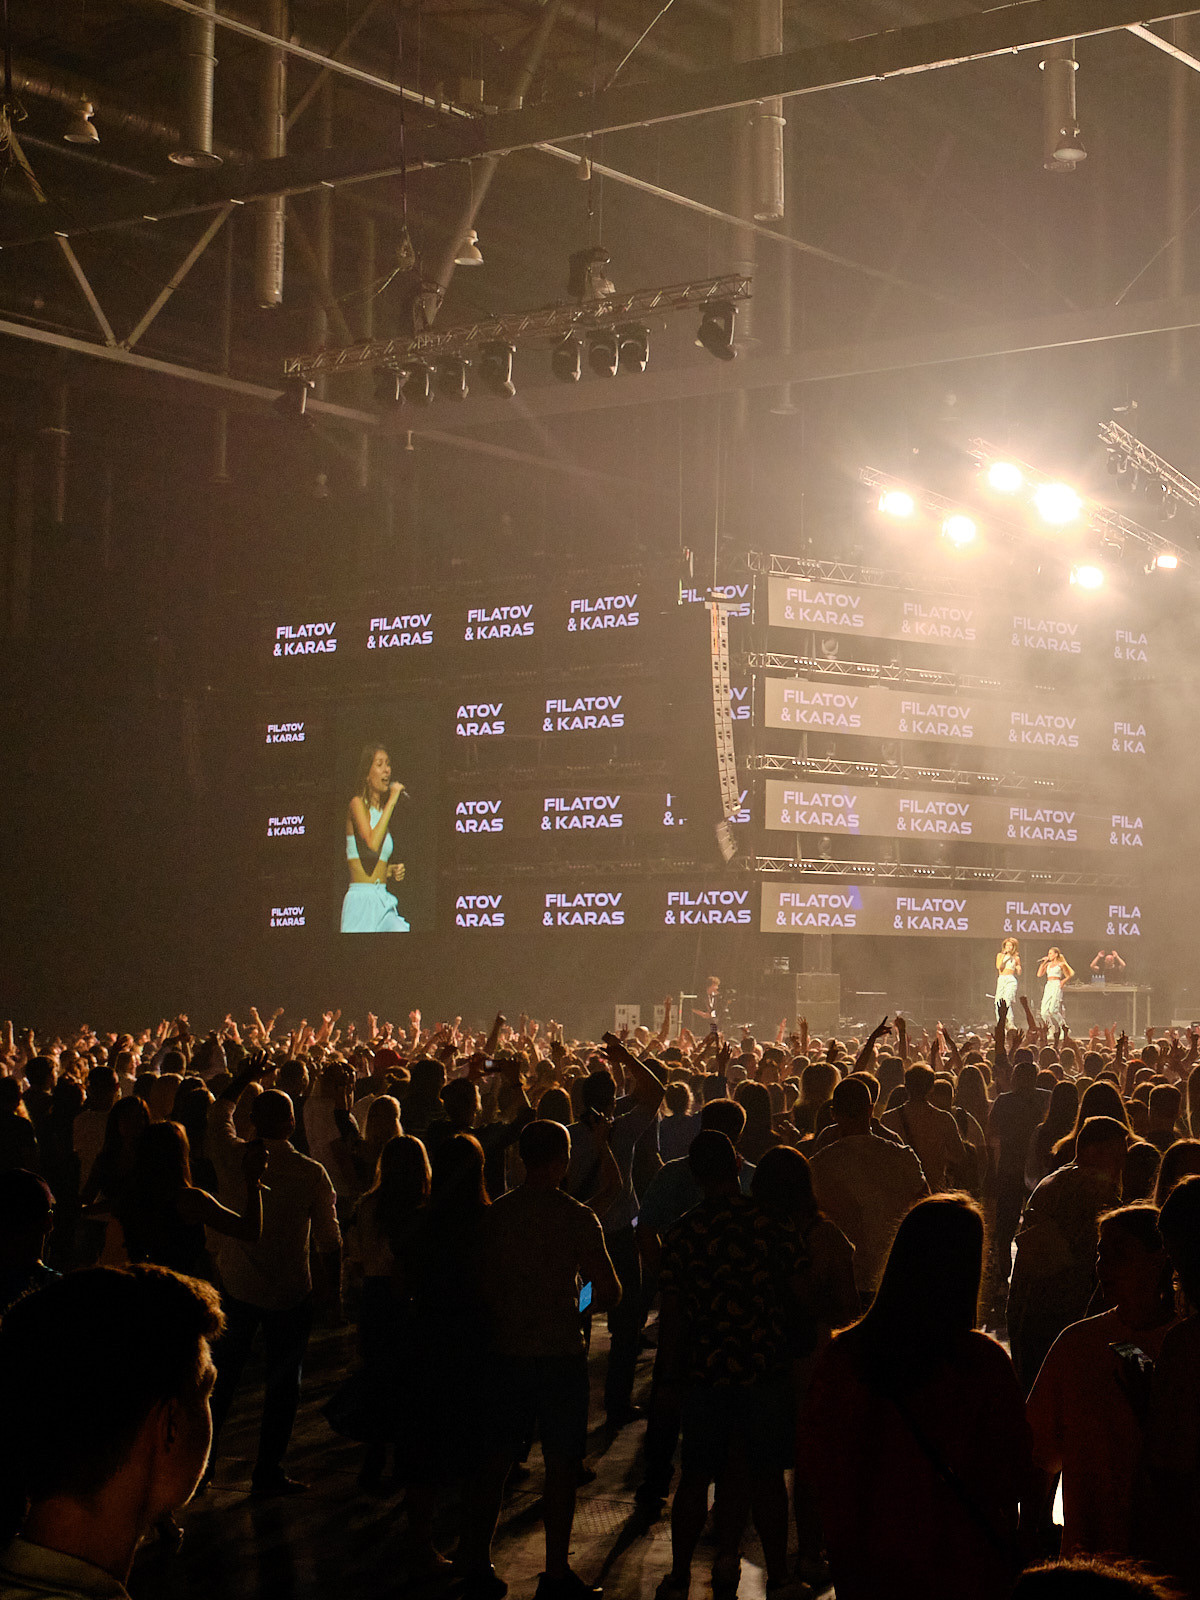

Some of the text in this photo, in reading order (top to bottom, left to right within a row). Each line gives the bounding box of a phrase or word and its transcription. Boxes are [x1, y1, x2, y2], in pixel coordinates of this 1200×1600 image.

[571, 594, 637, 613] FILATOV
[787, 588, 860, 608] FILATOV
[468, 605, 533, 622] FILATOV
[784, 605, 864, 627] & KARAS
[904, 603, 972, 622] FILATOV
[370, 614, 431, 631] FILATOV
[568, 612, 639, 631] & KARAS
[1014, 616, 1078, 635] FILATOV
[277, 622, 336, 639] FILATOV
[465, 622, 534, 640] & KARAS
[901, 620, 976, 640] & KARAS
[274, 639, 337, 656] & KARAS
[367, 631, 433, 649] & KARAS
[1012, 633, 1081, 653] & KARAS
[1114, 646, 1122, 658] &
[546, 696, 622, 713] FILATOV
[784, 689, 858, 708] FILATOV
[457, 703, 503, 718] ATOV
[781, 707, 861, 727] & KARAS
[901, 701, 970, 719] FILATOV
[267, 722, 304, 732] FILATOV
[543, 714, 624, 731] & KARAS
[899, 719, 973, 738] & KARAS
[1011, 712, 1076, 729] FILATOV
[265, 732, 305, 743] & KARAS
[1009, 729, 1079, 747] & KARAS
[1112, 738, 1120, 751] &
[456, 800, 501, 815] ATOV
[544, 796, 620, 811] FILATOV
[784, 791, 856, 808] FILATOV
[900, 799, 969, 816] FILATOV
[268, 815, 304, 826] FILATOV
[541, 814, 622, 830] & KARAS
[779, 809, 859, 828] & KARAS
[1010, 808, 1075, 823] FILATOV
[266, 825, 305, 836] & KARAS
[897, 817, 972, 834] & KARAS
[1007, 825, 1077, 841] & KARAS
[1110, 832, 1118, 844] &
[456, 895, 502, 909] ATOV
[546, 893, 622, 907] FILATOV
[668, 891, 748, 905] FILATOV
[780, 893, 854, 909] FILATOV
[897, 898, 966, 912] FILATOV
[271, 906, 304, 916] FILATOV
[665, 910, 751, 924] & KARAS
[1006, 902, 1071, 916] FILATOV
[269, 916, 305, 927] & KARAS
[543, 911, 624, 926] & KARAS
[776, 911, 856, 927] & KARAS
[894, 915, 968, 930] & KARAS
[1004, 918, 1073, 933] & KARAS
[1106, 922, 1115, 935] &
